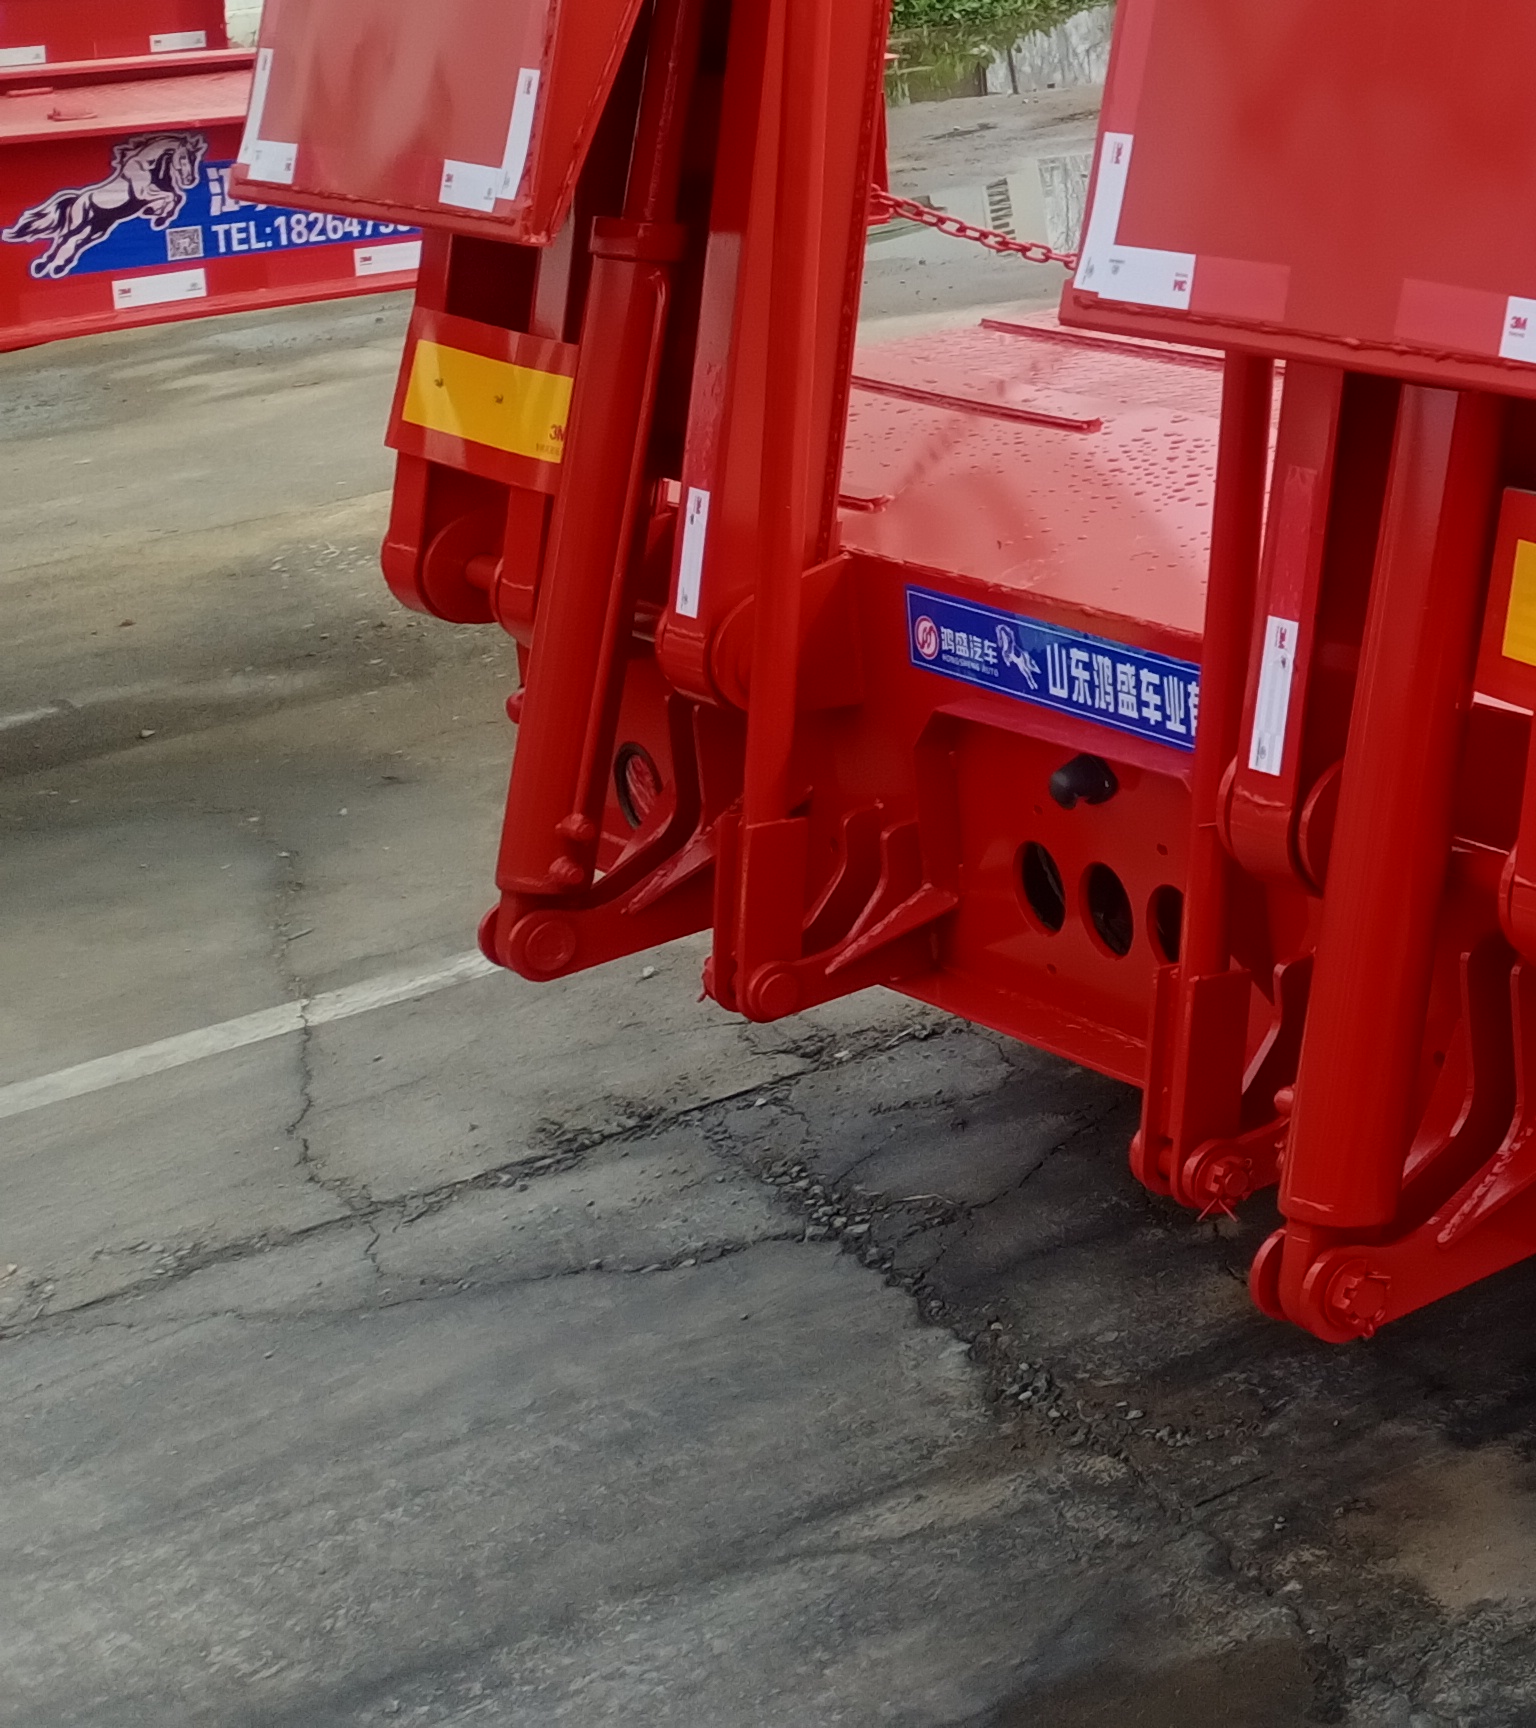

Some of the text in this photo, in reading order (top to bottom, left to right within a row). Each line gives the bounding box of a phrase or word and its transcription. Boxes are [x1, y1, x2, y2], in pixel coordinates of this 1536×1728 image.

[1509, 315, 1528, 332] 3M
[940, 625, 999, 665] 鸿盛汽车
